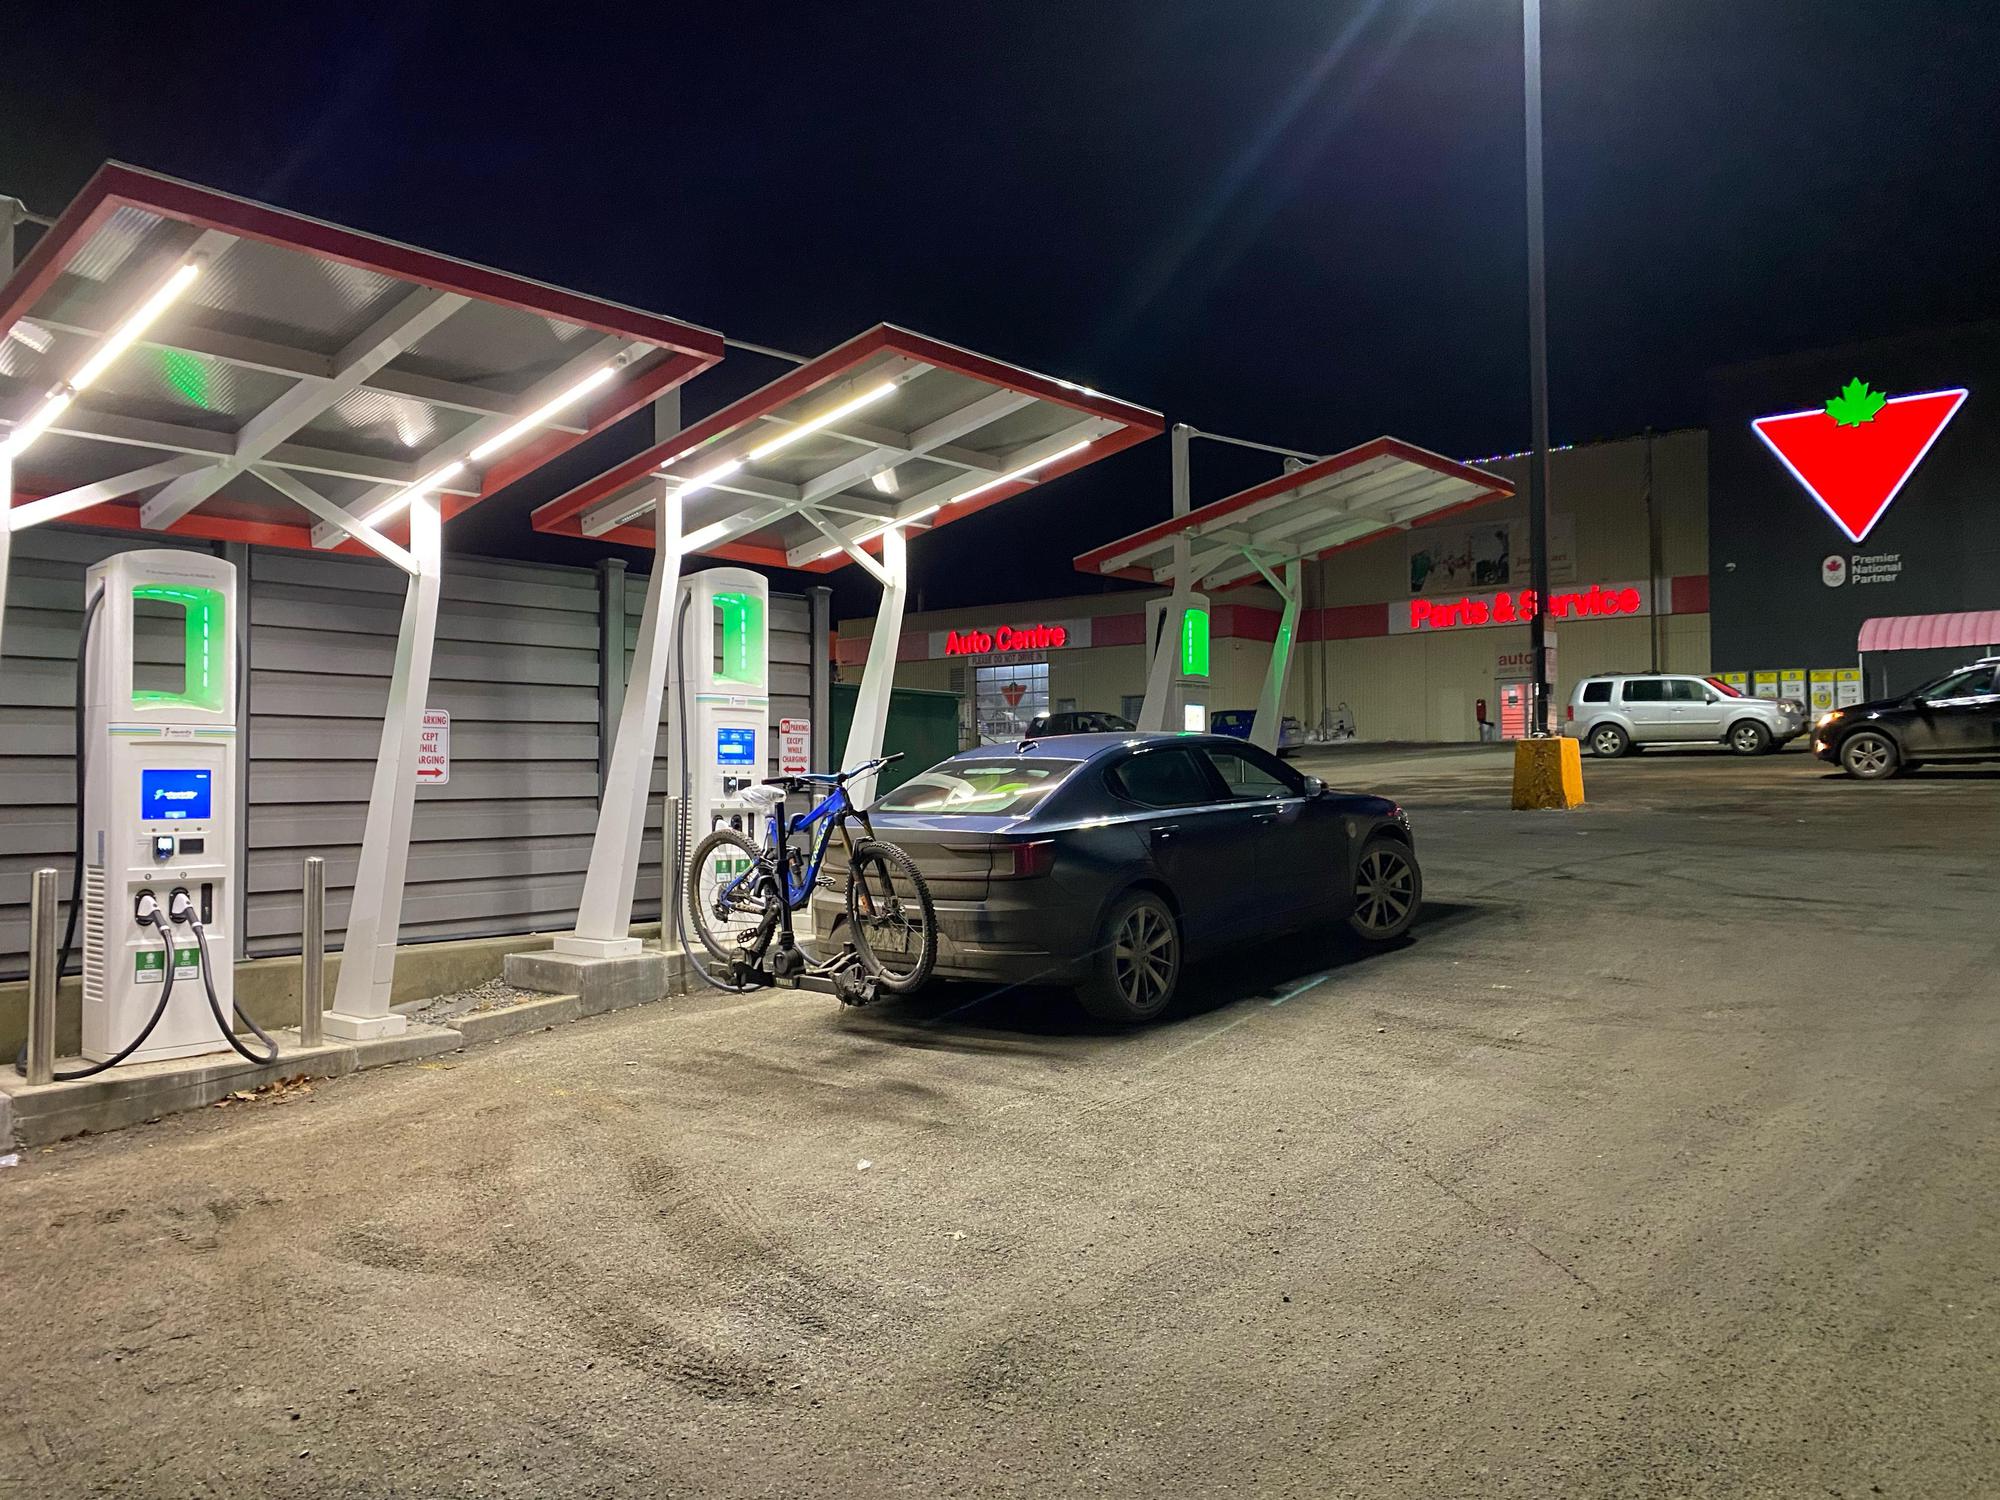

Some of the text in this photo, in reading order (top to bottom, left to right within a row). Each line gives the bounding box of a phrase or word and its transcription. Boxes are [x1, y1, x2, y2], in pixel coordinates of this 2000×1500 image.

[1851, 553, 1900, 564] Premier
[1851, 562, 1902, 574] National
[1852, 574, 1898, 584] Partner
[1410, 597, 1489, 629] Parts
[1493, 592, 1517, 623] &
[945, 624, 1067, 656] Auto Centre
[423, 716, 447, 724] ARKING
[422, 733, 439, 741] CEPT
